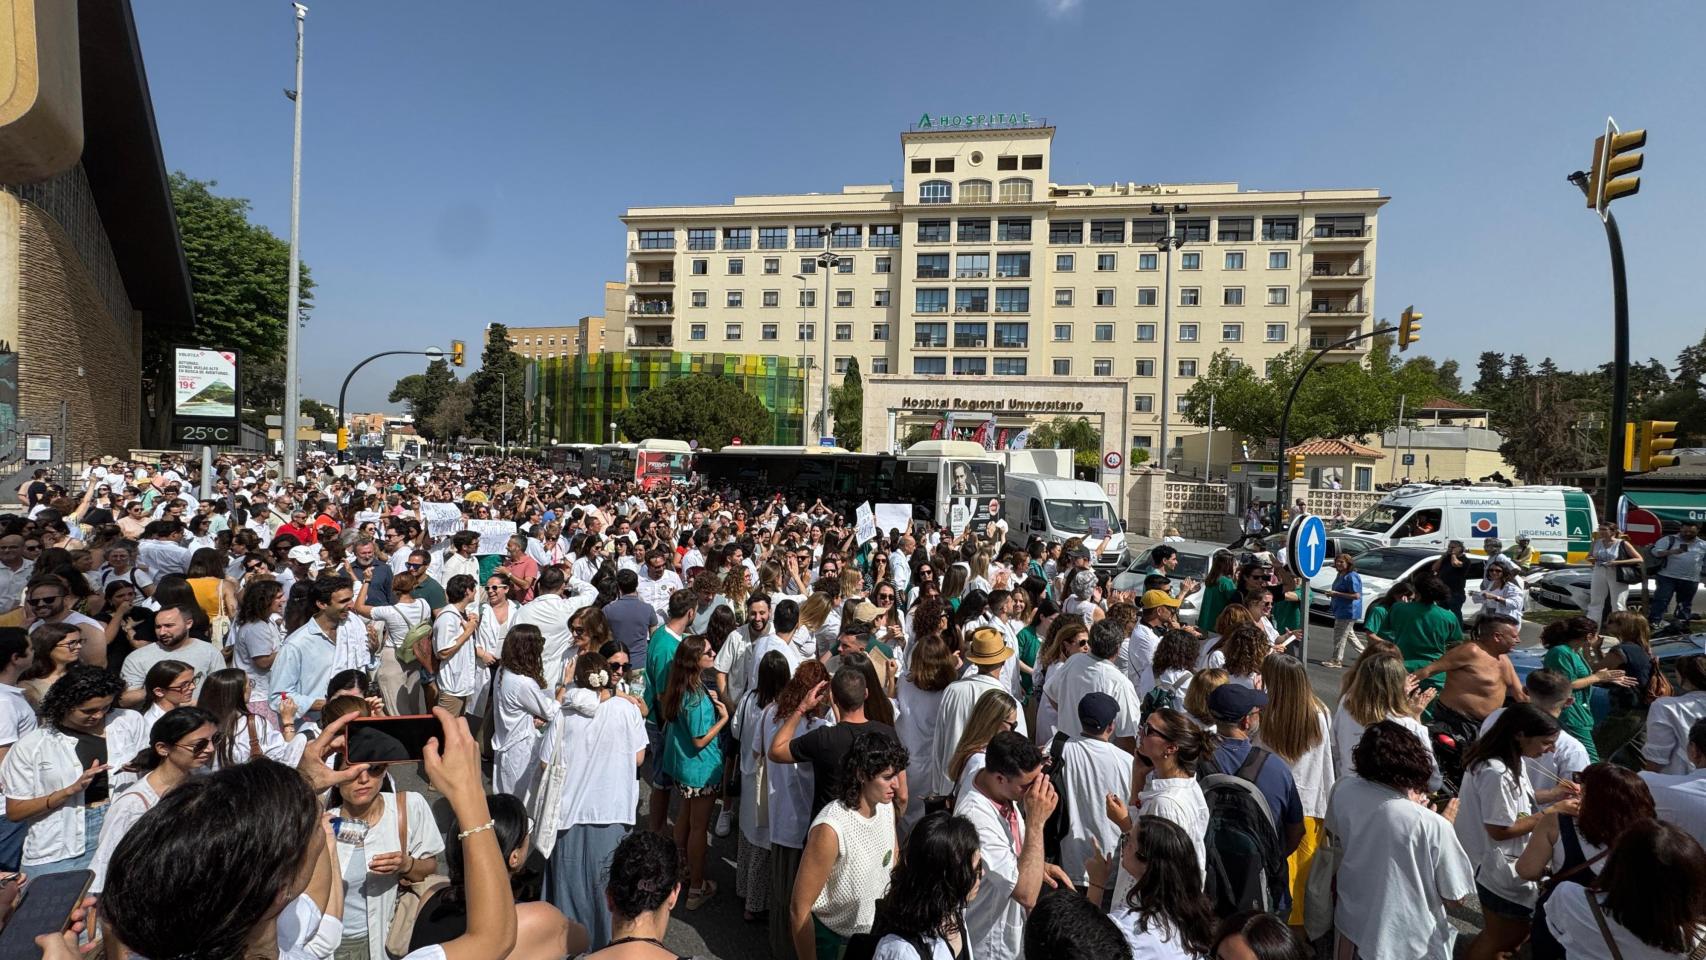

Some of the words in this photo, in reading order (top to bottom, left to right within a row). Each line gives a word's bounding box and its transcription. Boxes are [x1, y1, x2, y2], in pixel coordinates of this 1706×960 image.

[940, 112, 1030, 126] HOSPITAL
[179, 381, 196, 390] 19€
[902, 397, 949, 411] Hospital
[953, 398, 1005, 411] Regional
[1007, 399, 1084, 411] Universitario
[183, 426, 229, 441] 25°C
[1404, 456, 1412, 464] P
[1518, 529, 1562, 537] URGENCIAS
